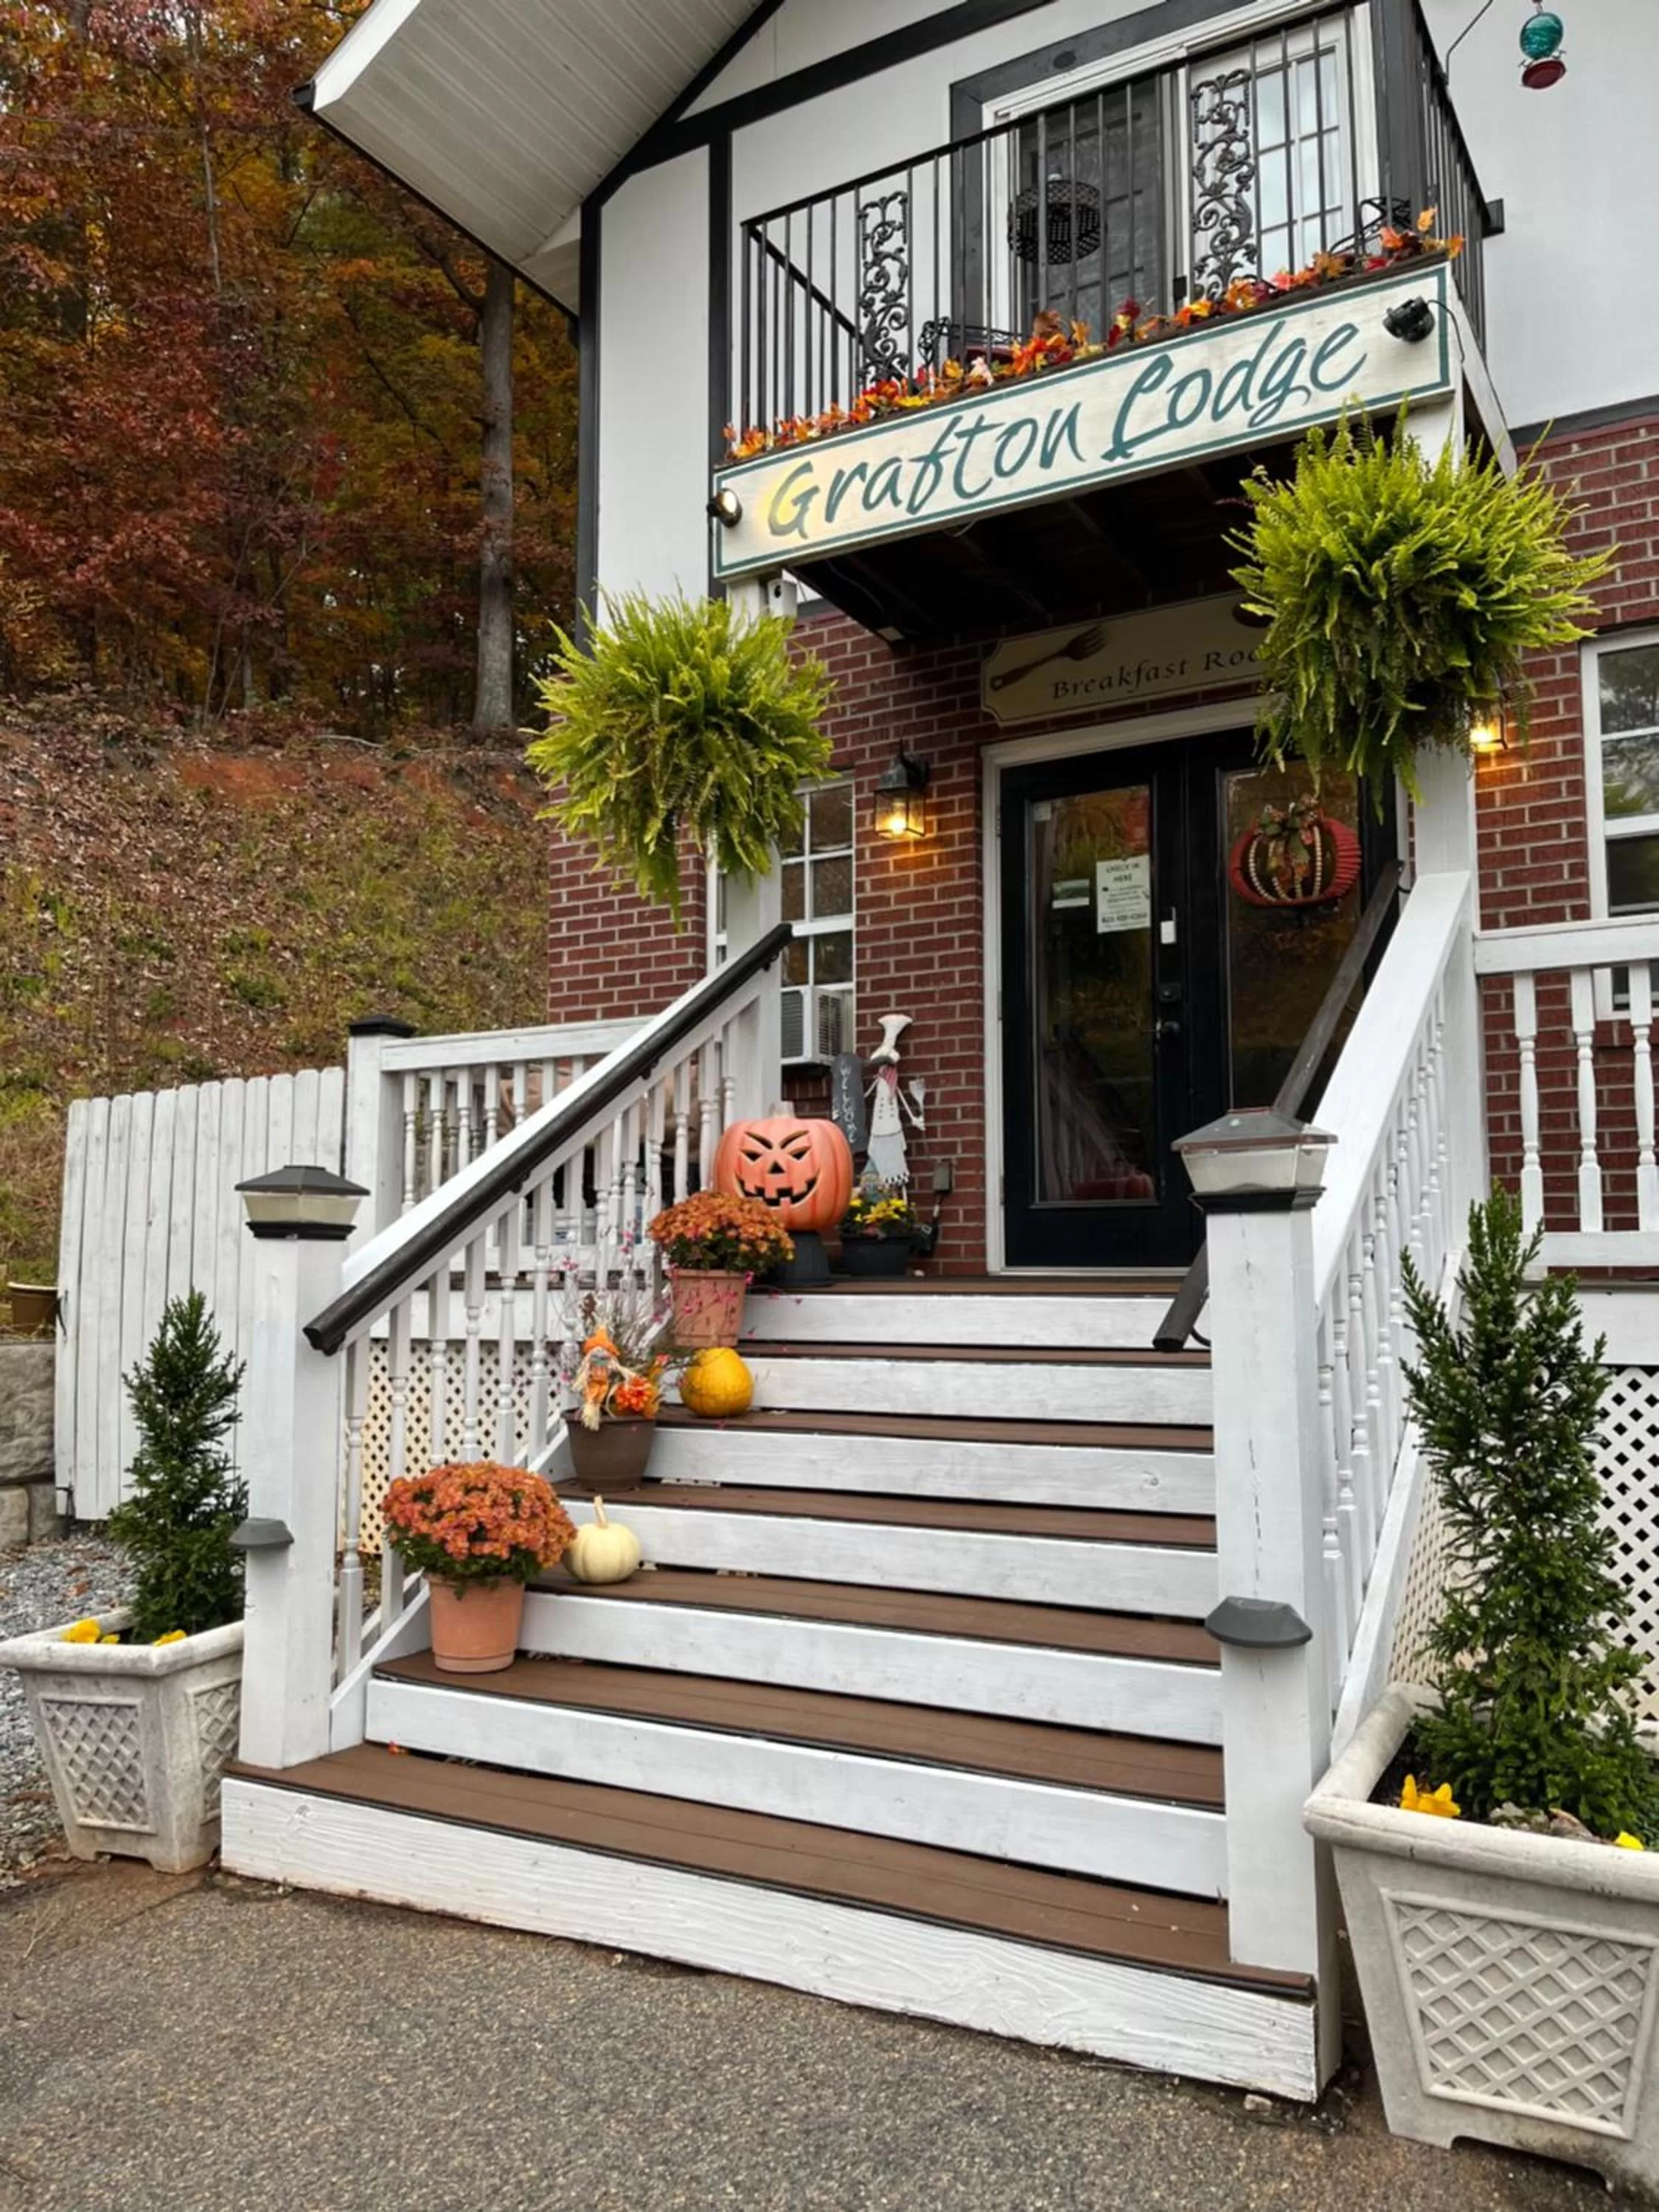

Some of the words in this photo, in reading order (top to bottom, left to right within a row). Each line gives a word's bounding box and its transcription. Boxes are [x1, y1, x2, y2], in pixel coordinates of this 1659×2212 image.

[768, 403, 1085, 538] Grafton
[1101, 321, 1367, 462] Lodge
[1053, 659, 1187, 699] Breakfast
[1203, 649, 1257, 672] Roo
